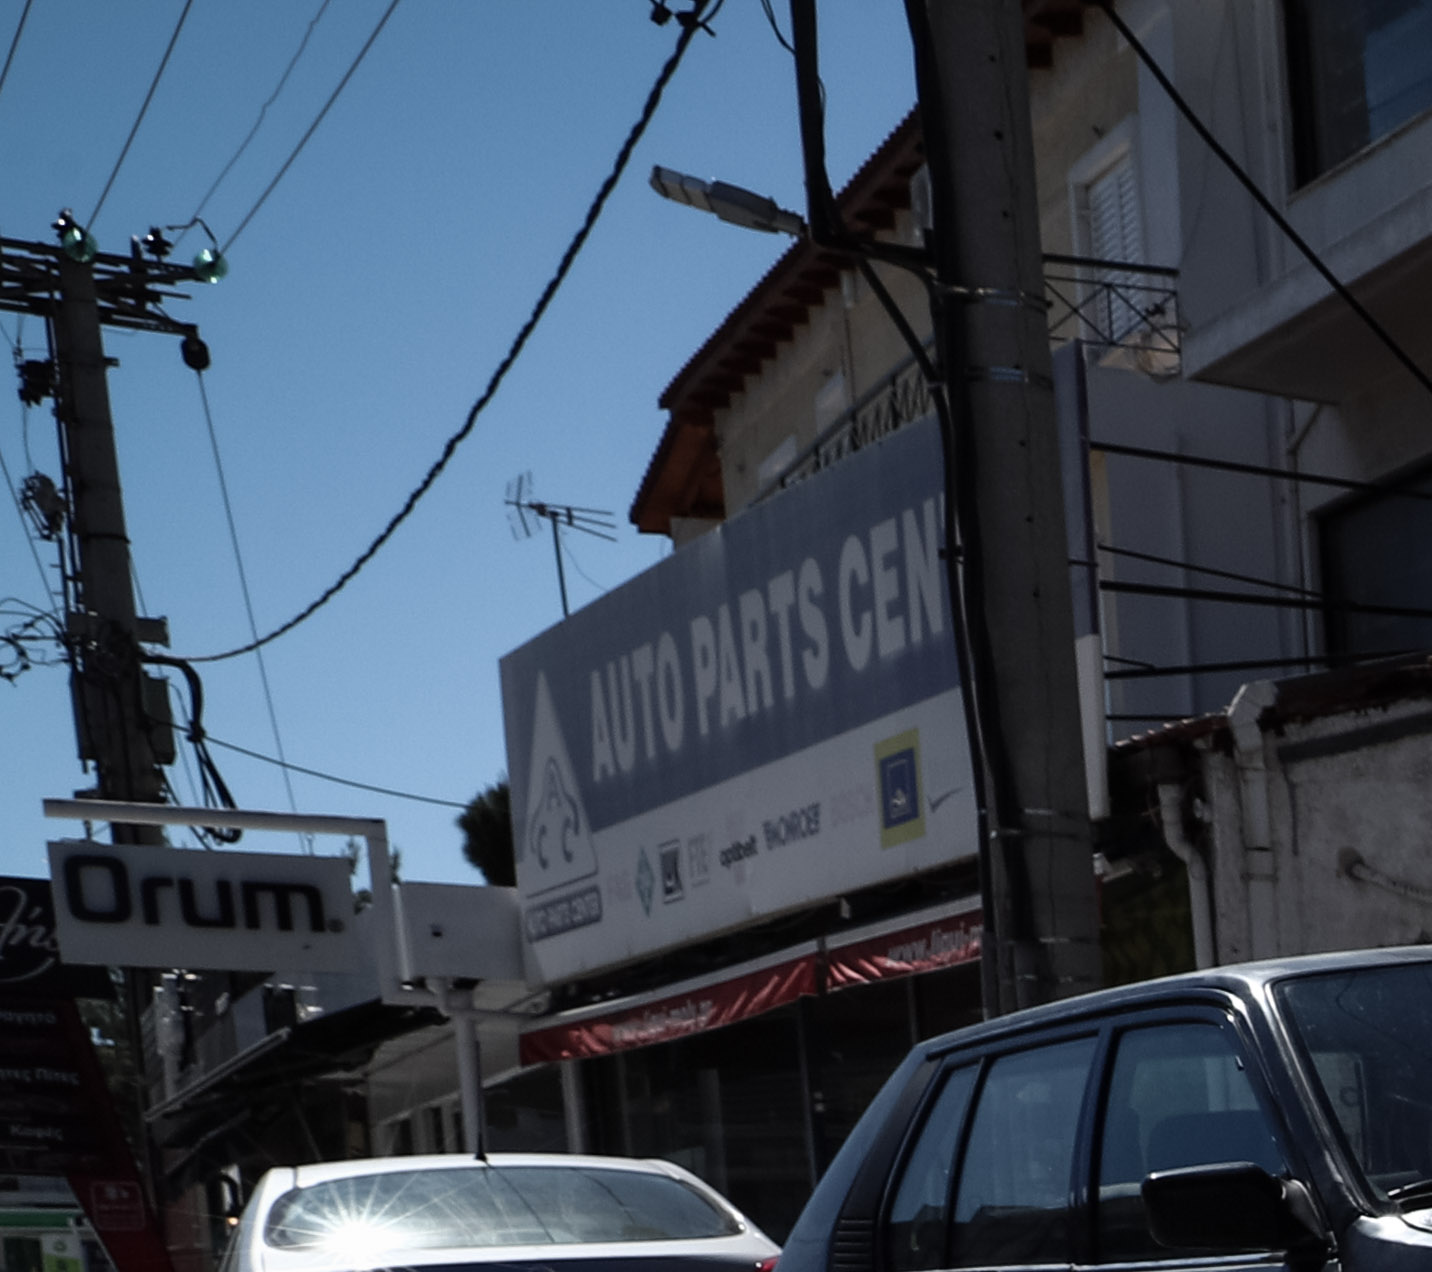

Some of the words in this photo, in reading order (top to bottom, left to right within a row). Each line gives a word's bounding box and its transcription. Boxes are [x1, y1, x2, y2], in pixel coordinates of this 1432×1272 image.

[590, 630, 685, 784] AUTO
[689, 557, 831, 738] PARTS
[838, 489, 946, 673] CEN
